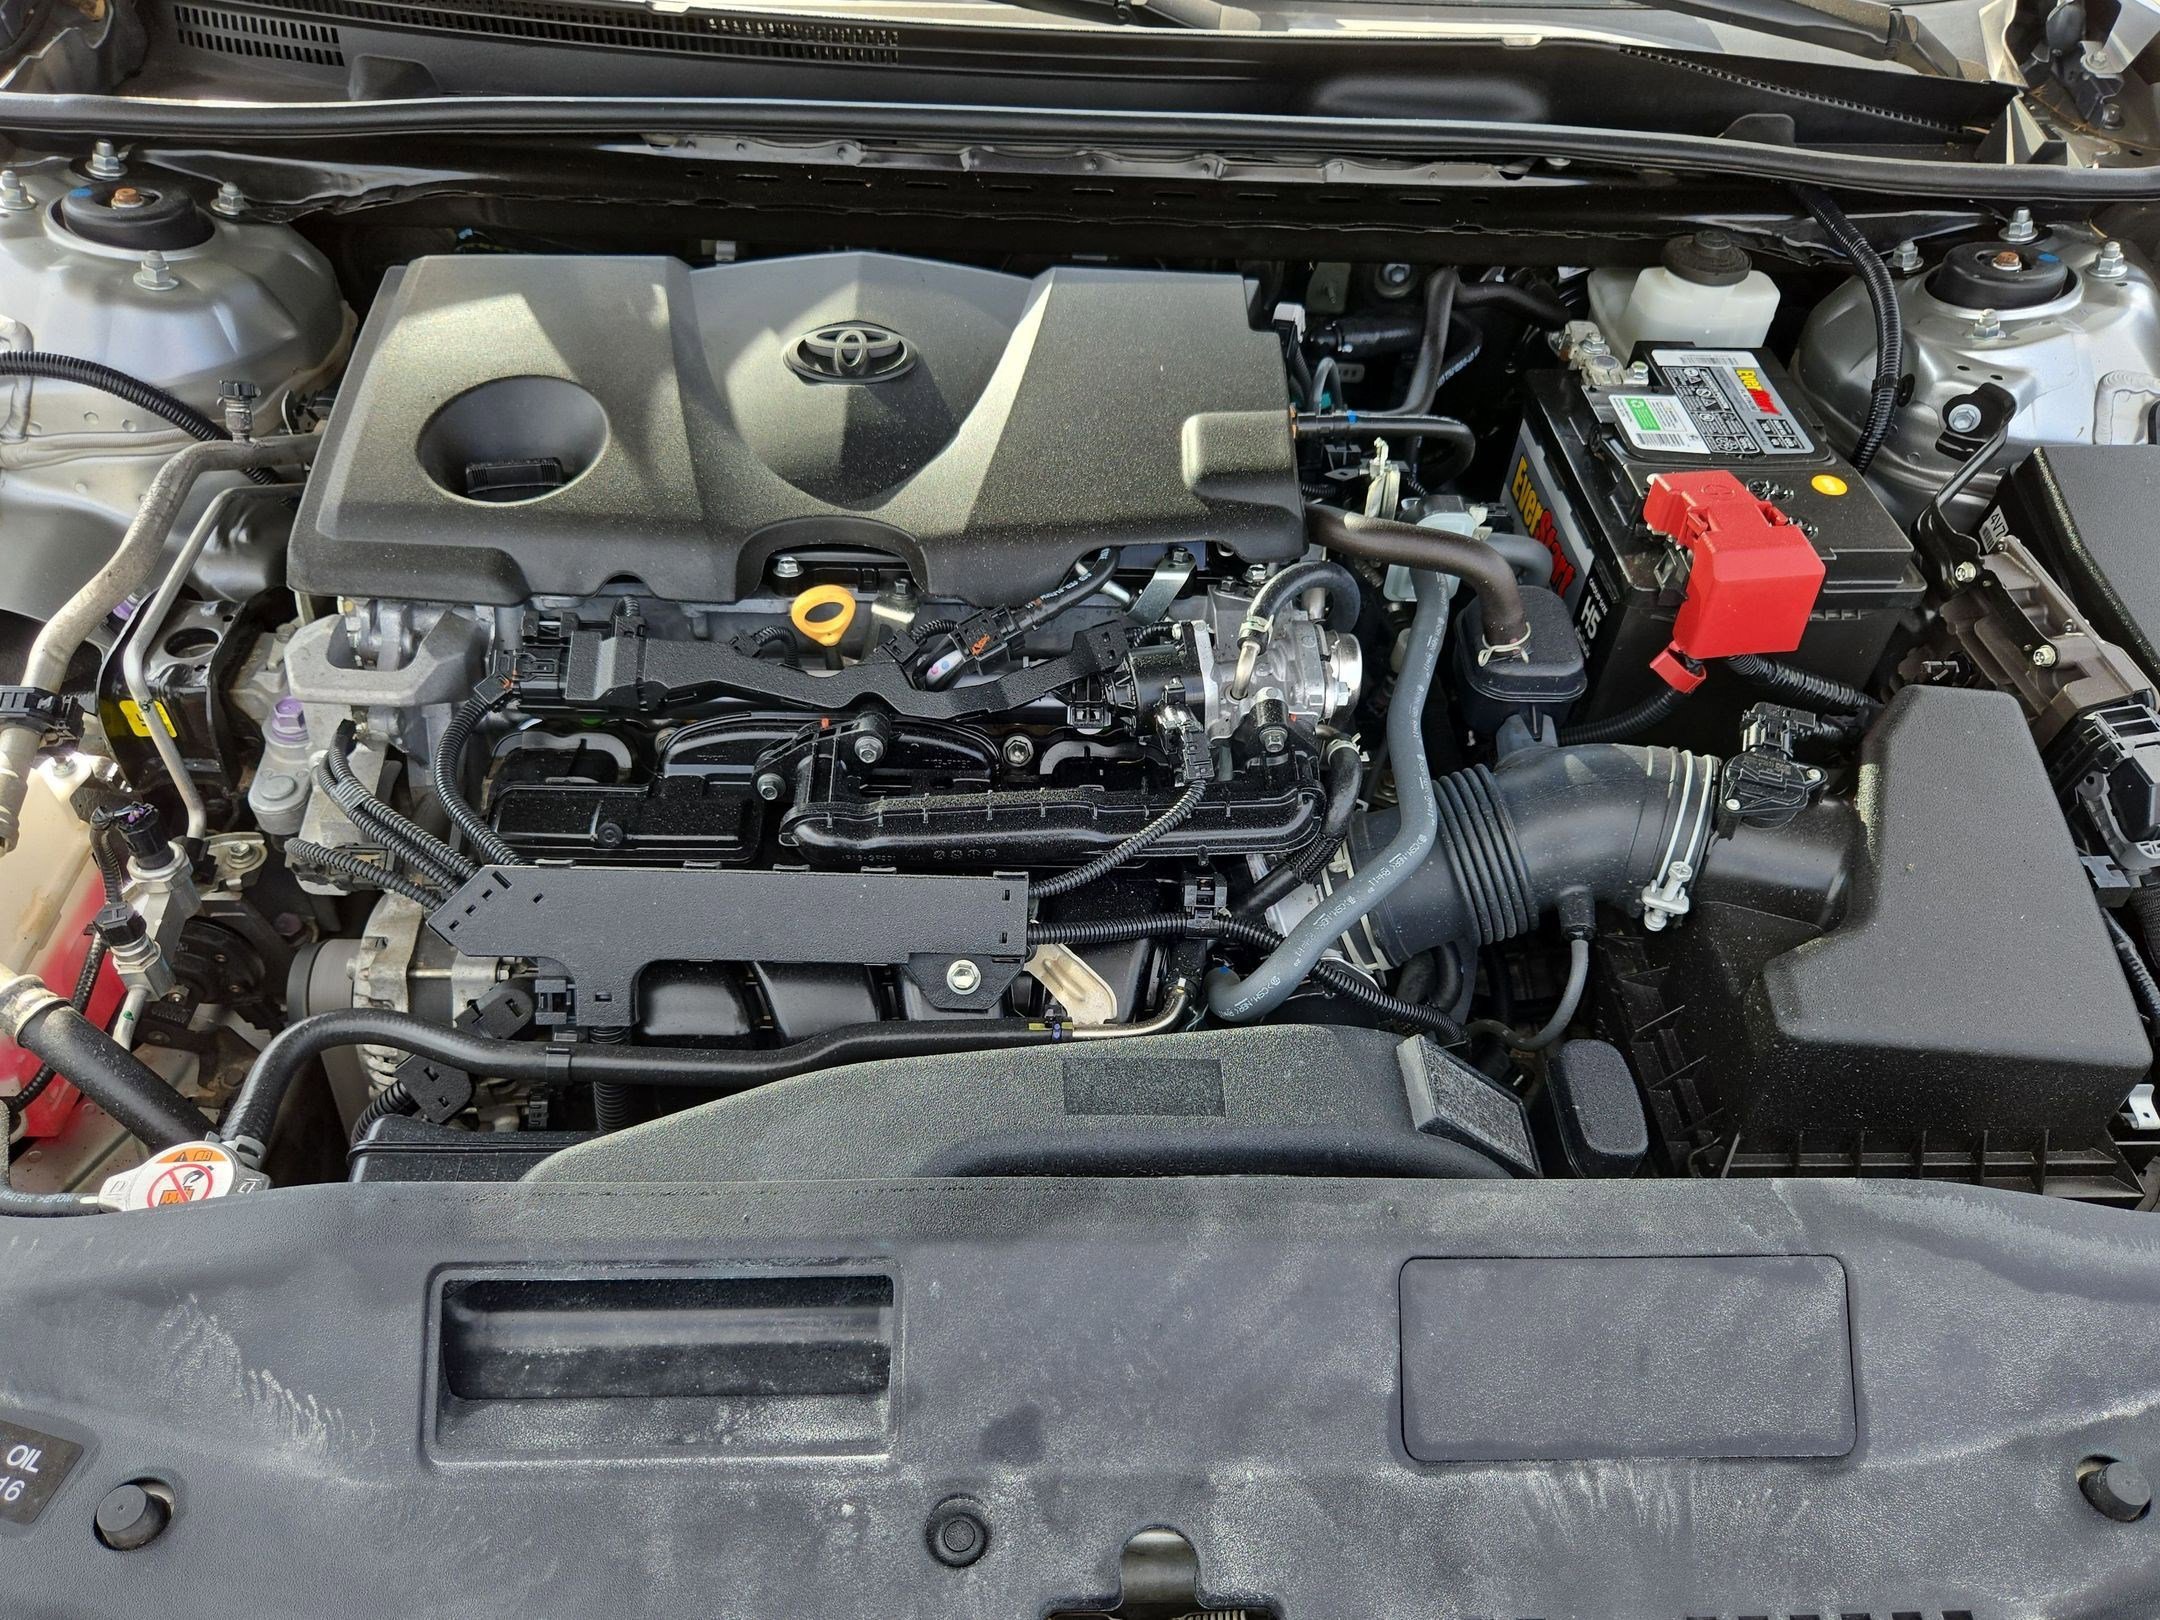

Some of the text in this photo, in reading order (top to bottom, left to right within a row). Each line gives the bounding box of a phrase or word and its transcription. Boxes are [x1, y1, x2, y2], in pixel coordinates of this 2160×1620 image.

[1990, 513, 2006, 538] 4V7
[1580, 595, 1602, 640] H5
[6, 1444, 43, 1474] OIL
